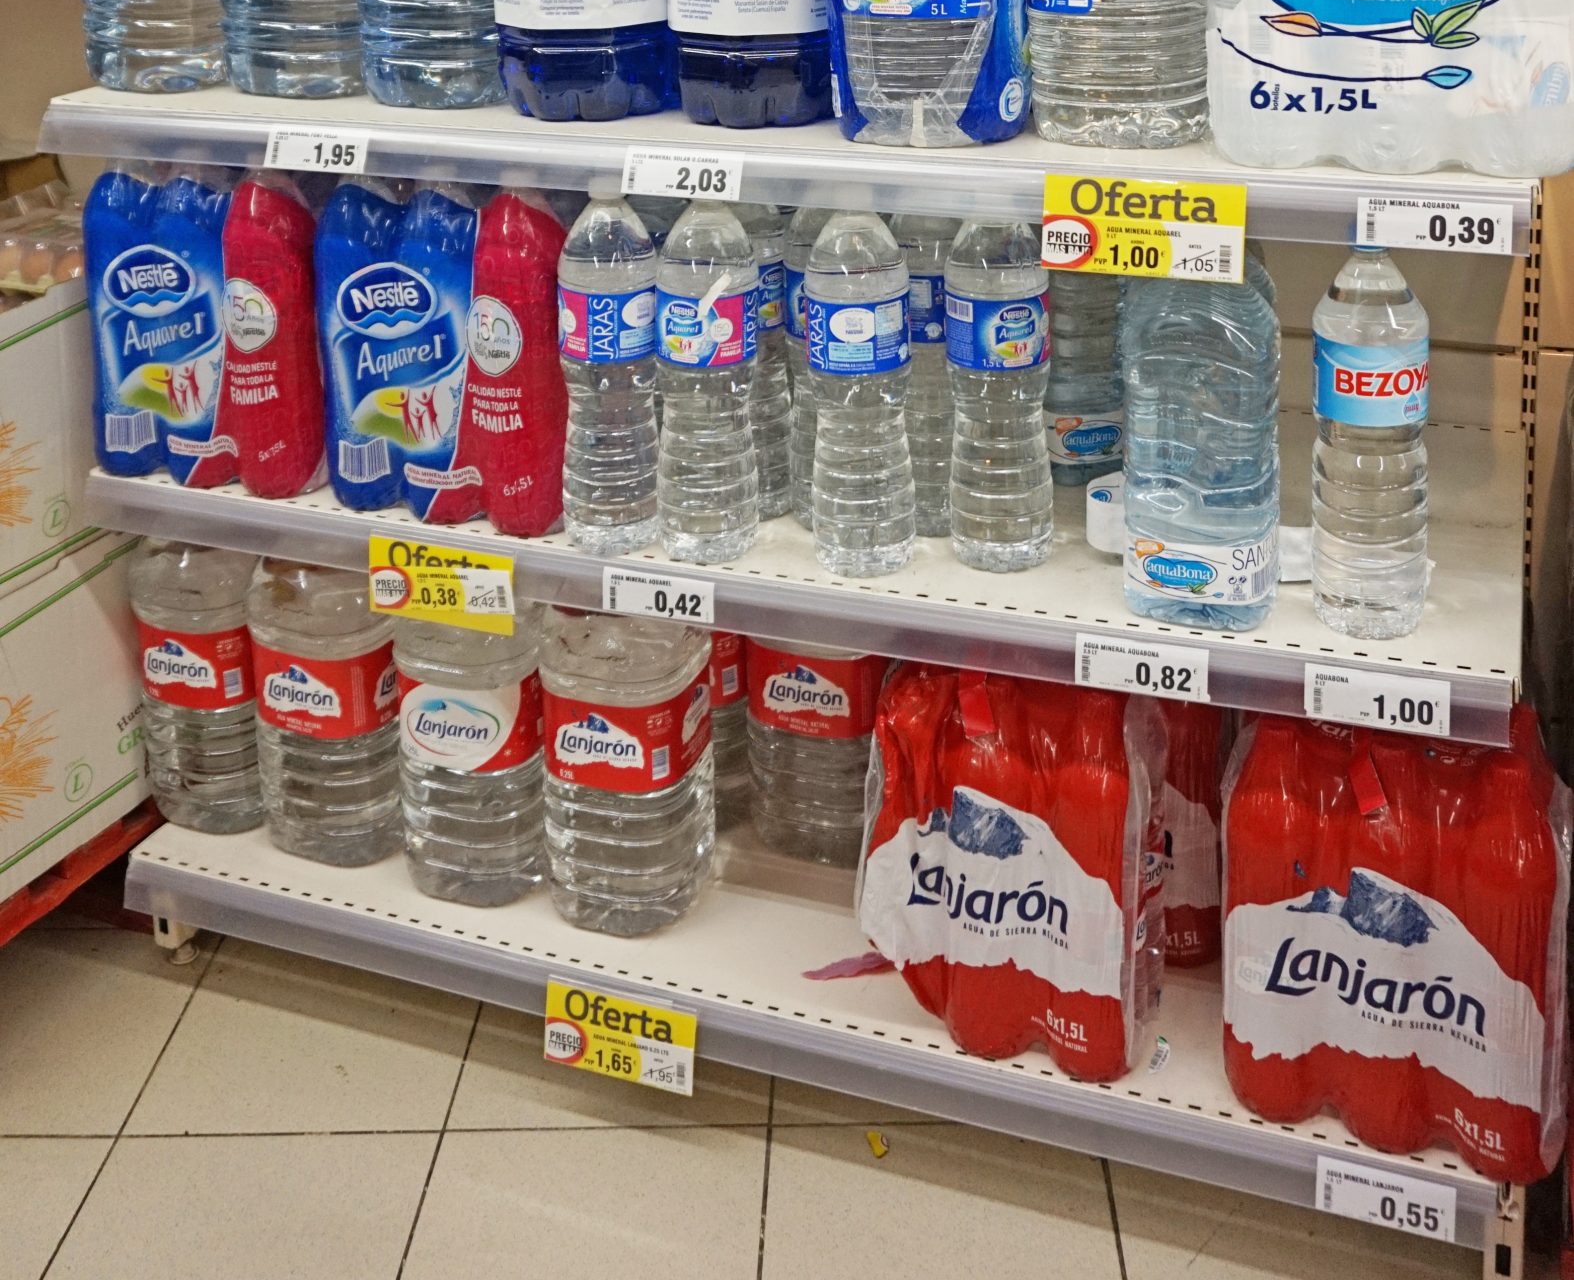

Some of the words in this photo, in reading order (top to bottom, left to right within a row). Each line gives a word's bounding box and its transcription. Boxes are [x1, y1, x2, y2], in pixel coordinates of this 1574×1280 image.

[1250, 80, 1269, 109] 6
[313, 143, 356, 168] 1,95
[676, 166, 727, 196] 2,03
[1070, 178, 1218, 222] Oferta
[1369, 198, 1386, 206] AGUA
[1389, 200, 1420, 208] MINERAL
[1422, 201, 1460, 210] AQUABONA
[1047, 230, 1091, 245] PRECIO
[1107, 226, 1122, 234] AGUA
[1125, 227, 1151, 236] MINERAL
[1153, 228, 1181, 238] AQUAREL
[1429, 214, 1495, 248] 0,39
[1094, 257, 1107, 266] PVP
[1109, 245, 1159, 273] 1,00
[1181, 257, 1213, 273] 1,05
[123, 313, 204, 356] Aquarel
[591, 296, 613, 360] JARAS
[667, 322, 700, 336] Aquarel
[808, 302, 824, 369] JARAS
[999, 326, 1034, 341] Aquarel
[226, 360, 249, 371] CALIDAD
[357, 337, 444, 380] Aquarel
[468, 383, 495, 397] CALIDAD
[1335, 360, 1430, 397] BEZOYA
[230, 383, 278, 404] FAMILIA
[471, 410, 523, 431] FAMILIA
[375, 579, 407, 589] PRECIO
[1147, 561, 1212, 582] aquaBona
[421, 588, 457, 609] 0,38
[471, 595, 494, 608] 0,42
[654, 591, 701, 617] 0,42
[1083, 642, 1099, 651] AGUA
[1100, 644, 1126, 655] MINERAL
[1128, 649, 1159, 658] AQUABONA
[146, 654, 208, 679] Lanjarón
[1135, 662, 1192, 693] 0,82
[1315, 674, 1349, 684] AQUABONA
[268, 679, 333, 708] Lanjarón
[769, 678, 843, 706] Lanjarón
[1373, 695, 1434, 726] 1,00
[414, 712, 489, 742] Lanjarón
[560, 731, 636, 758] Lanjarón
[907, 852, 1067, 935] Lanjarón
[963, 922, 984, 935] AGUA
[1006, 927, 1037, 936] SIERRA
[1265, 937, 1486, 1037] Lanjarón
[564, 989, 673, 1044] Oferta
[1047, 1009, 1087, 1042] 6x1,5L
[550, 1030, 581, 1046] PRECIO
[1361, 1010, 1387, 1024] AGUA
[1409, 1021, 1444, 1033] SIERRA
[1451, 1029, 1487, 1053] NEVADA
[596, 1049, 632, 1074] 1,65
[1455, 1108, 1505, 1151] 6x1,5L
[1372, 1179, 1404, 1193] LANJARON
[1380, 1196, 1439, 1232] 0,55
